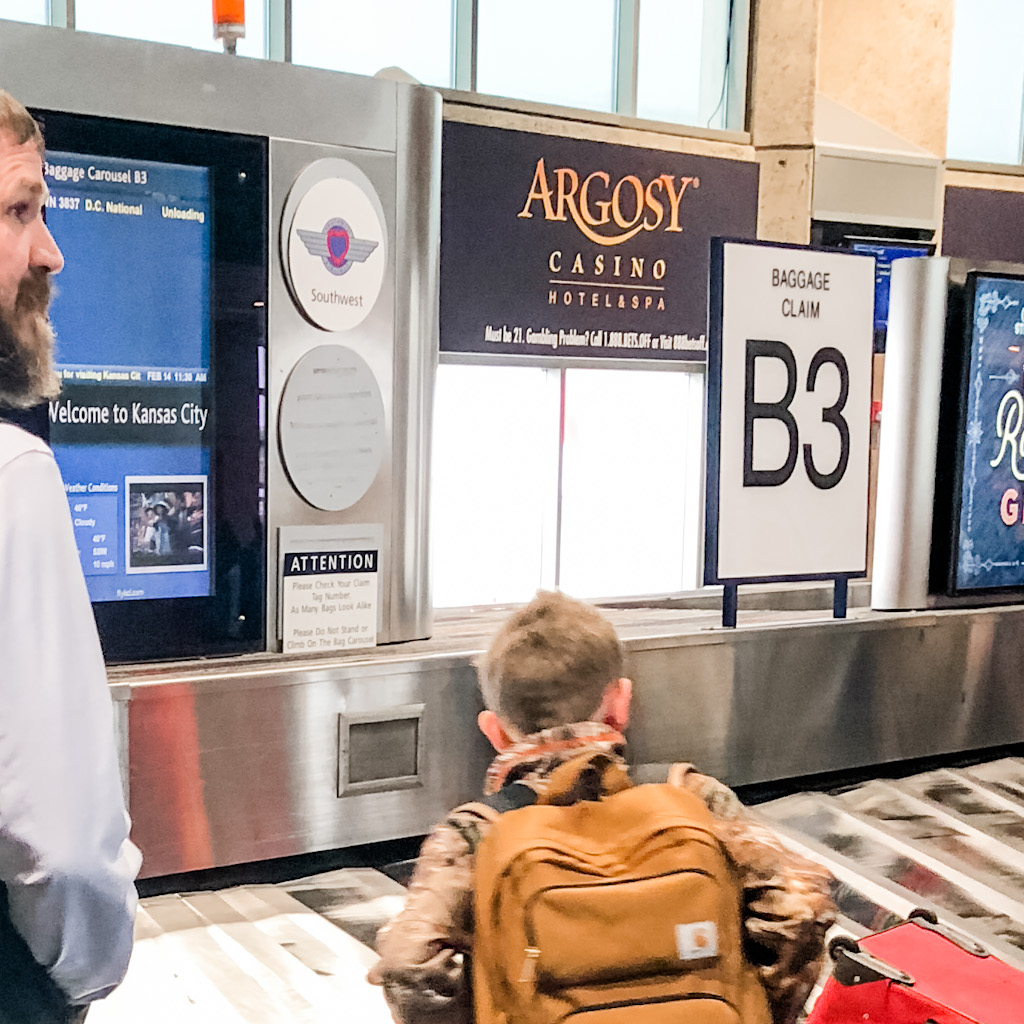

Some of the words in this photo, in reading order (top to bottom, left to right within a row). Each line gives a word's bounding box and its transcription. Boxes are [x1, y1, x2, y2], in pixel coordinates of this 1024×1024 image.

[88, 165, 131, 184] Carousel
[134, 171, 148, 184] B3
[85, 198, 105, 212] D.C.
[106, 201, 143, 216] National
[162, 206, 205, 223] Unloading
[517, 157, 694, 246] ARGOSY
[548, 250, 667, 280] CASINO
[772, 268, 830, 291] BAGGAGE
[311, 288, 363, 307] Southwest
[781, 298, 820, 319] CLAIM
[113, 403, 128, 424] to
[132, 402, 177, 425] Kansas
[180, 402, 208, 430] City
[742, 338, 850, 490] B3
[290, 553, 374, 572] ATTENTION
[292, 581, 312, 591] Please
[314, 580, 334, 589] Check
[301, 605, 318, 616] Many
[321, 603, 337, 614] Bags
[338, 602, 354, 611] Look
[293, 628, 314, 637] Please
[327, 626, 340, 635] Not
[341, 625, 359, 634] Stand
[319, 638, 331, 648] The
